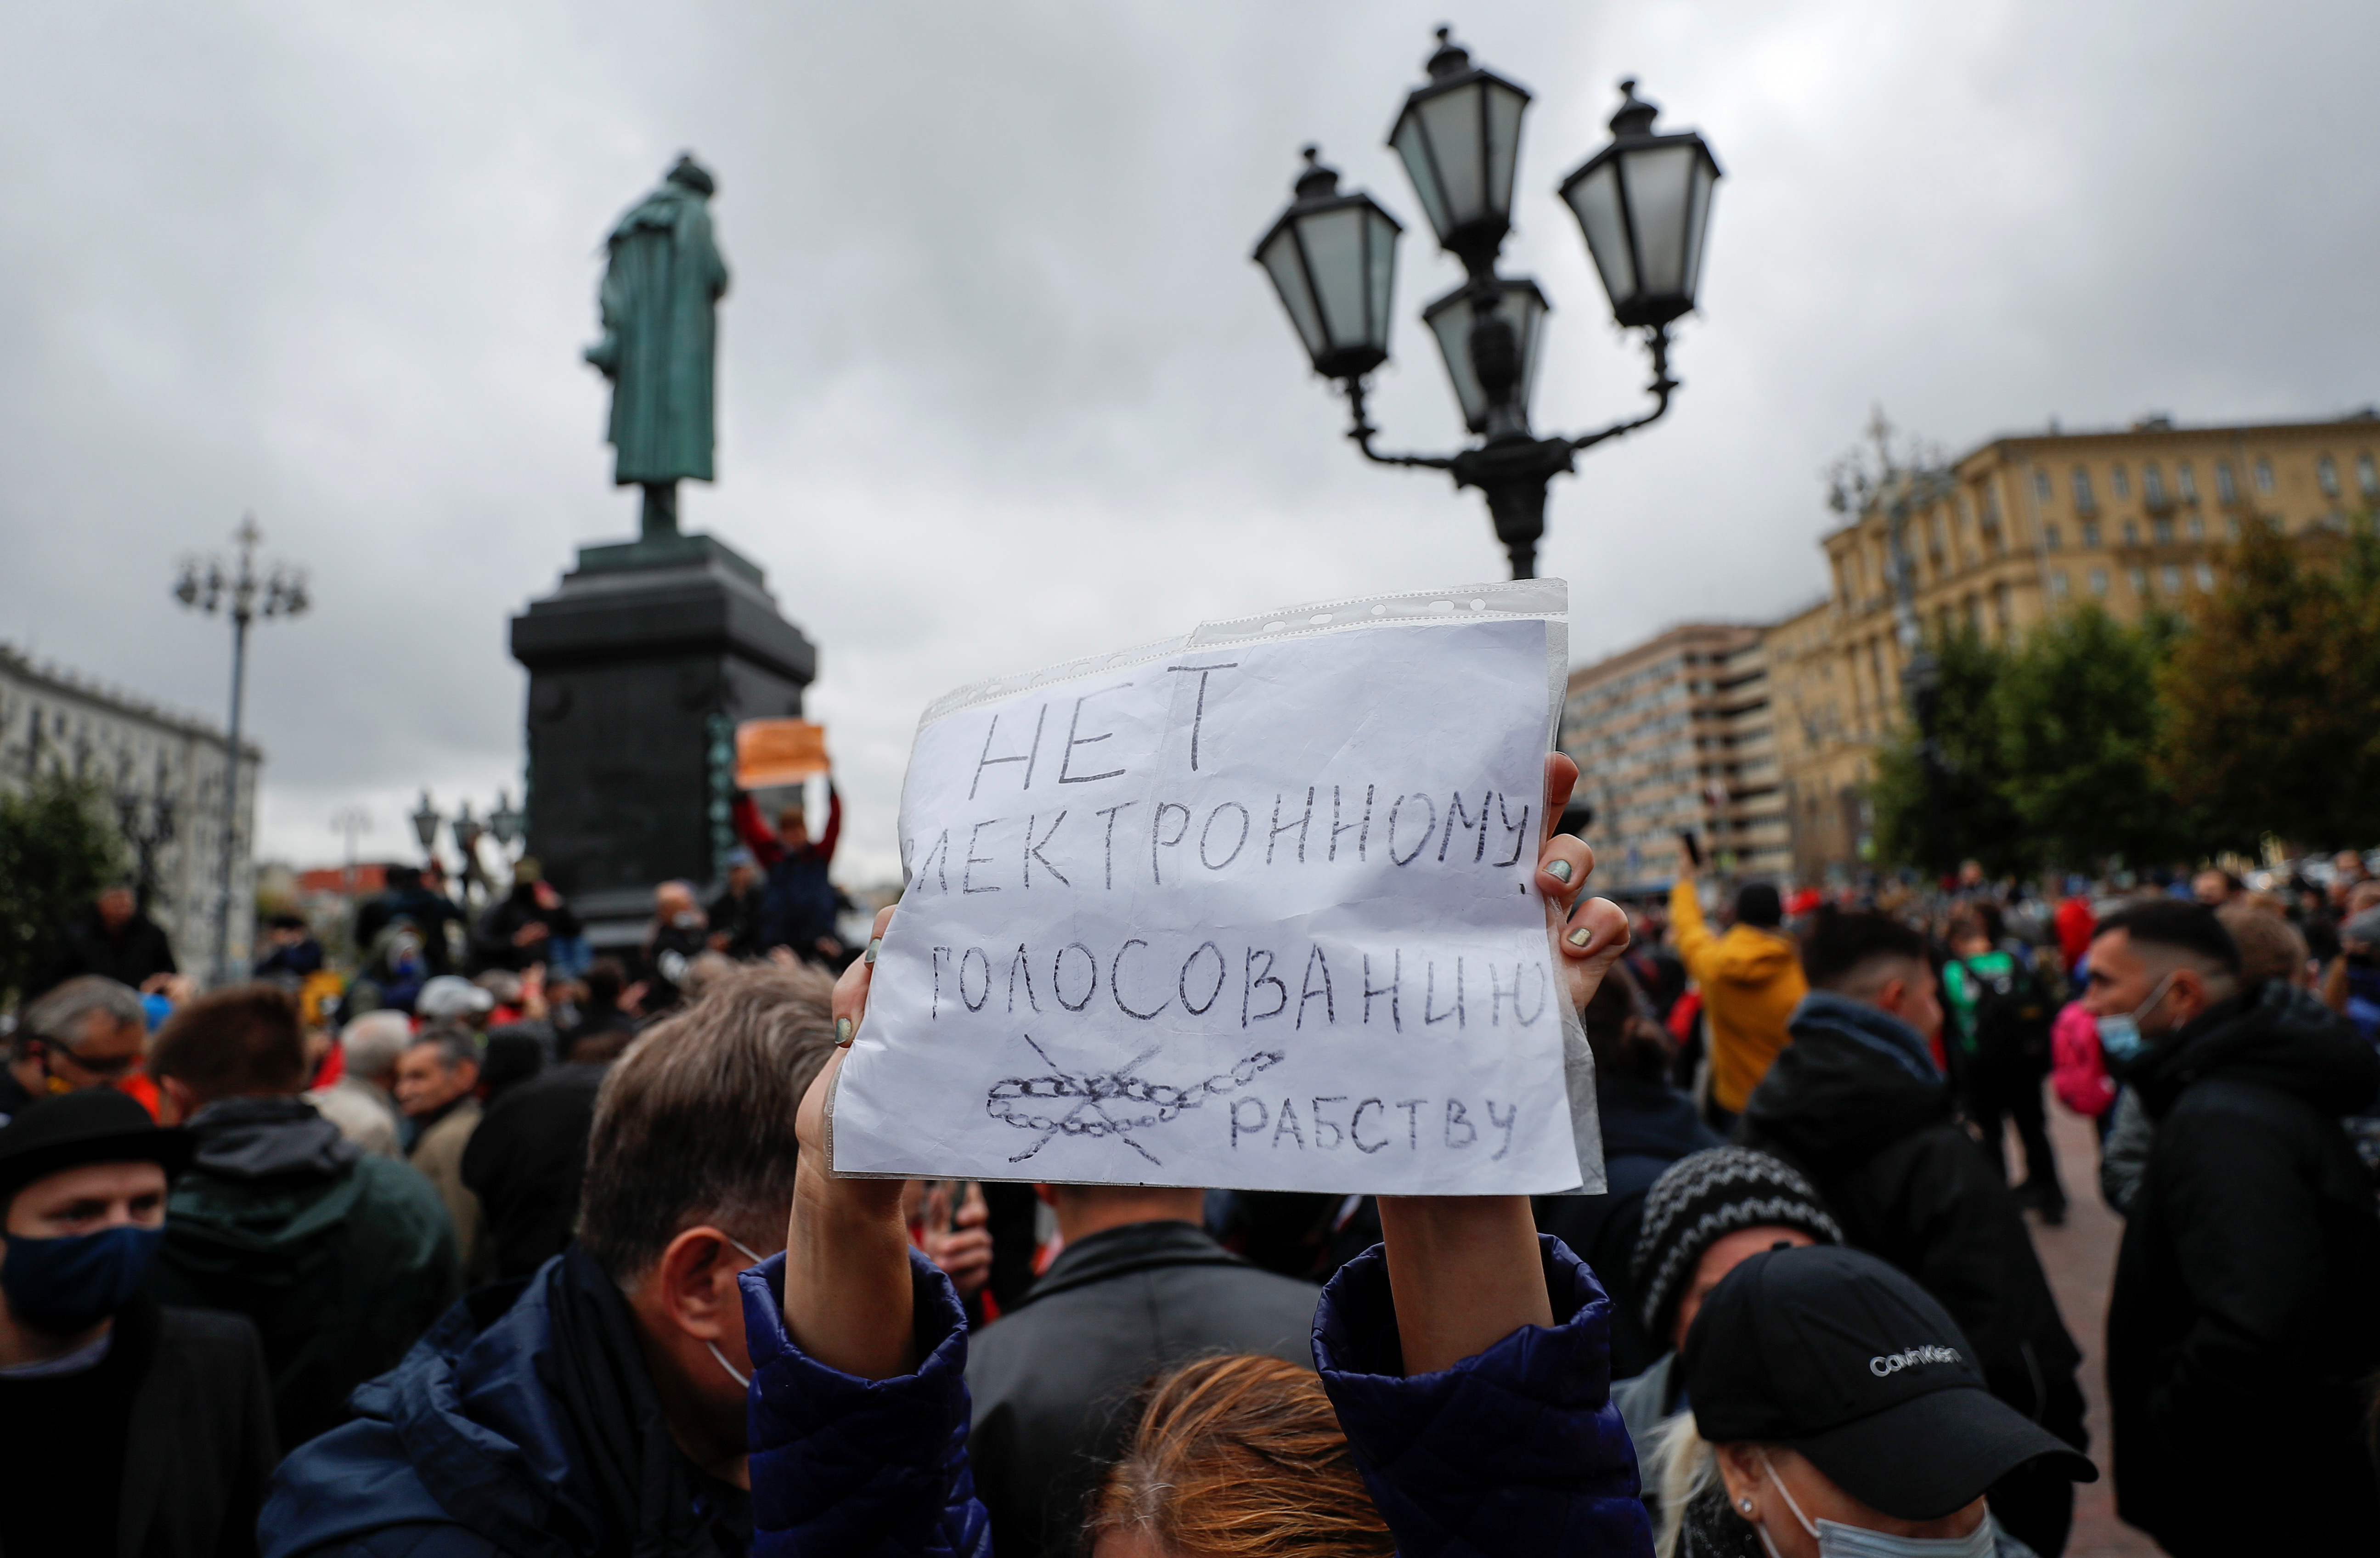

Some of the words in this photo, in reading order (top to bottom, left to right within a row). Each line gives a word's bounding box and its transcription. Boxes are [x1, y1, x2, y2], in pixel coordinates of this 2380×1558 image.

[968, 662, 1238, 801] НЕТ
[932, 938, 1546, 1035] ГОЛОСОВАНИЮ
[1229, 1096, 1517, 1162] РАБСТВУ
